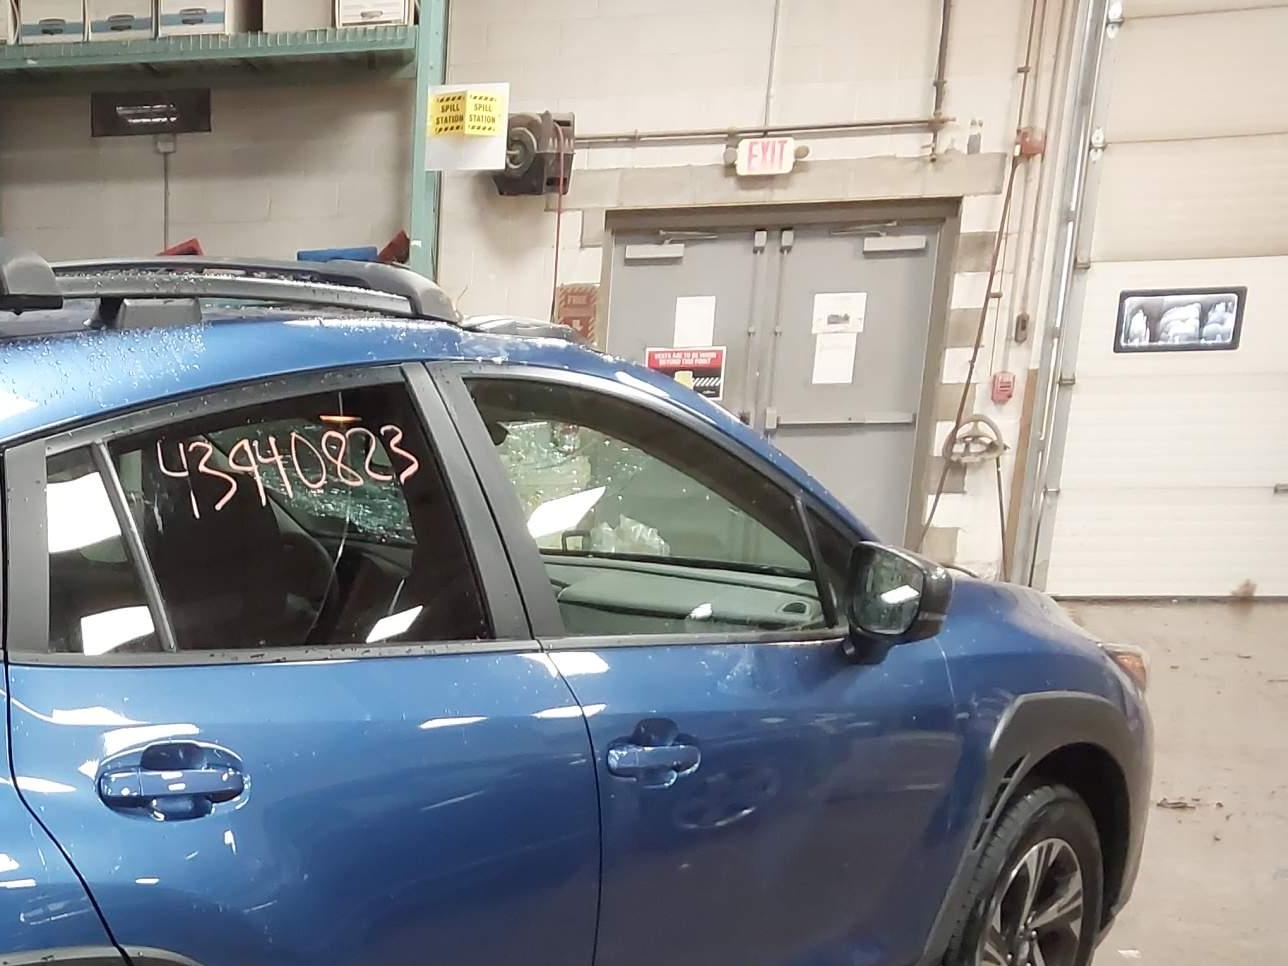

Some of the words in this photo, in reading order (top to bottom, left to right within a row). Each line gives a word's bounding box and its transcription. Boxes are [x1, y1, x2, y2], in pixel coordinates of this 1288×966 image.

[441, 104, 460, 113] SPILL
[474, 103, 492, 112] SPILL
[436, 115, 464, 125] STATION
[469, 114, 496, 123] STATION
[747, 140, 788, 171] EXIT
[157, 425, 418, 519] 43940823
